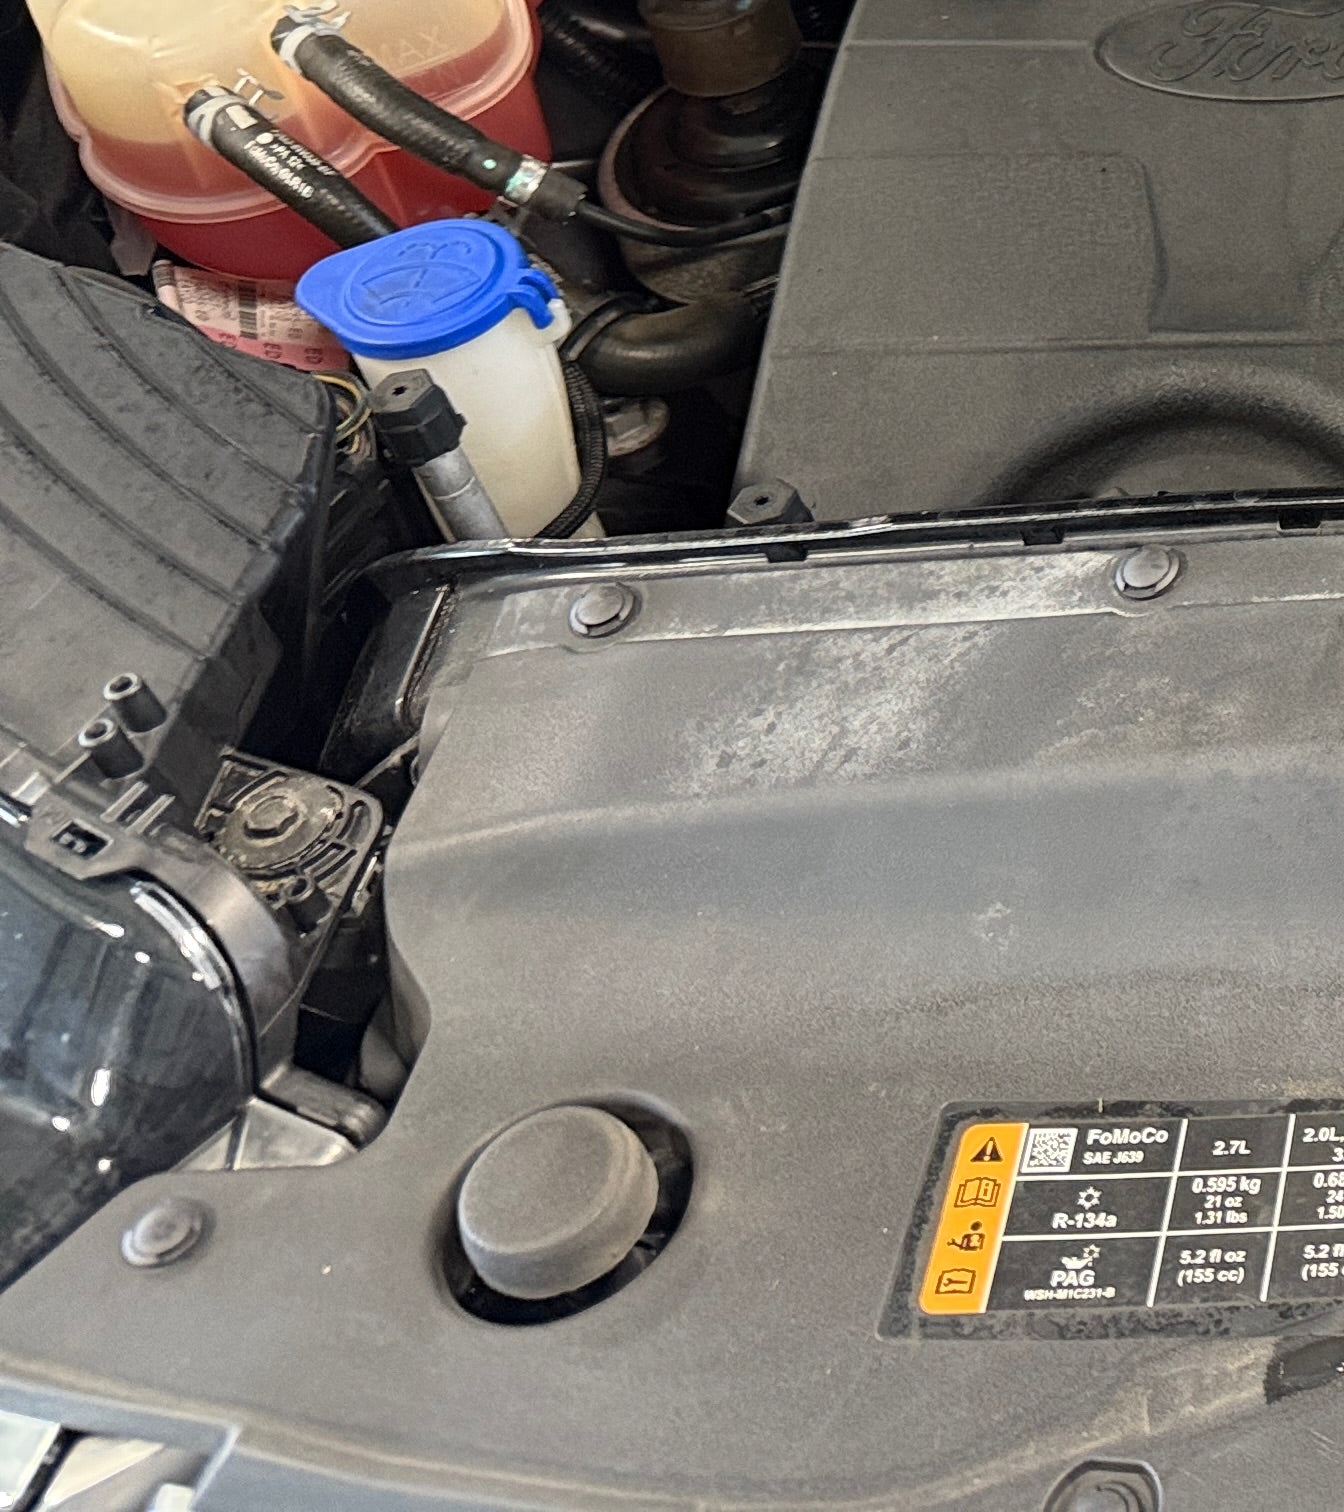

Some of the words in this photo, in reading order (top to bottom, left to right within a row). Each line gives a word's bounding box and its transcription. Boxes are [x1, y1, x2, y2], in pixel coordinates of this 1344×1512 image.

[1087, 1127, 1169, 1145] FoMoCo
[1303, 1127, 1344, 1142] 2.0L,
[1212, 1140, 1251, 1155] 2.7L
[1083, 1151, 1111, 1165] SAE
[1113, 1150, 1144, 1164] J639
[1191, 1176, 1237, 1193] 0.595
[1239, 1174, 1261, 1195] kg
[1204, 1195, 1221, 1208] 21
[1225, 1196, 1243, 1207] oz
[1326, 1190, 1344, 1203] 24
[1195, 1211, 1222, 1225] 1.31
[1226, 1210, 1248, 1224] lbs
[1317, 1206, 1344, 1219] 1.50
[1052, 1212, 1117, 1229] R-134a
[1179, 1250, 1206, 1264] 5.2
[1209, 1249, 1222, 1263] fl
[1224, 1250, 1246, 1262] oz
[1303, 1245, 1330, 1259] 5.2
[1332, 1244, 1344, 1257] fl
[1050, 1270, 1095, 1287] PAG
[1177, 1268, 1215, 1287] (155
[1217, 1267, 1244, 1284] cc)
[1301, 1263, 1339, 1281] (155
